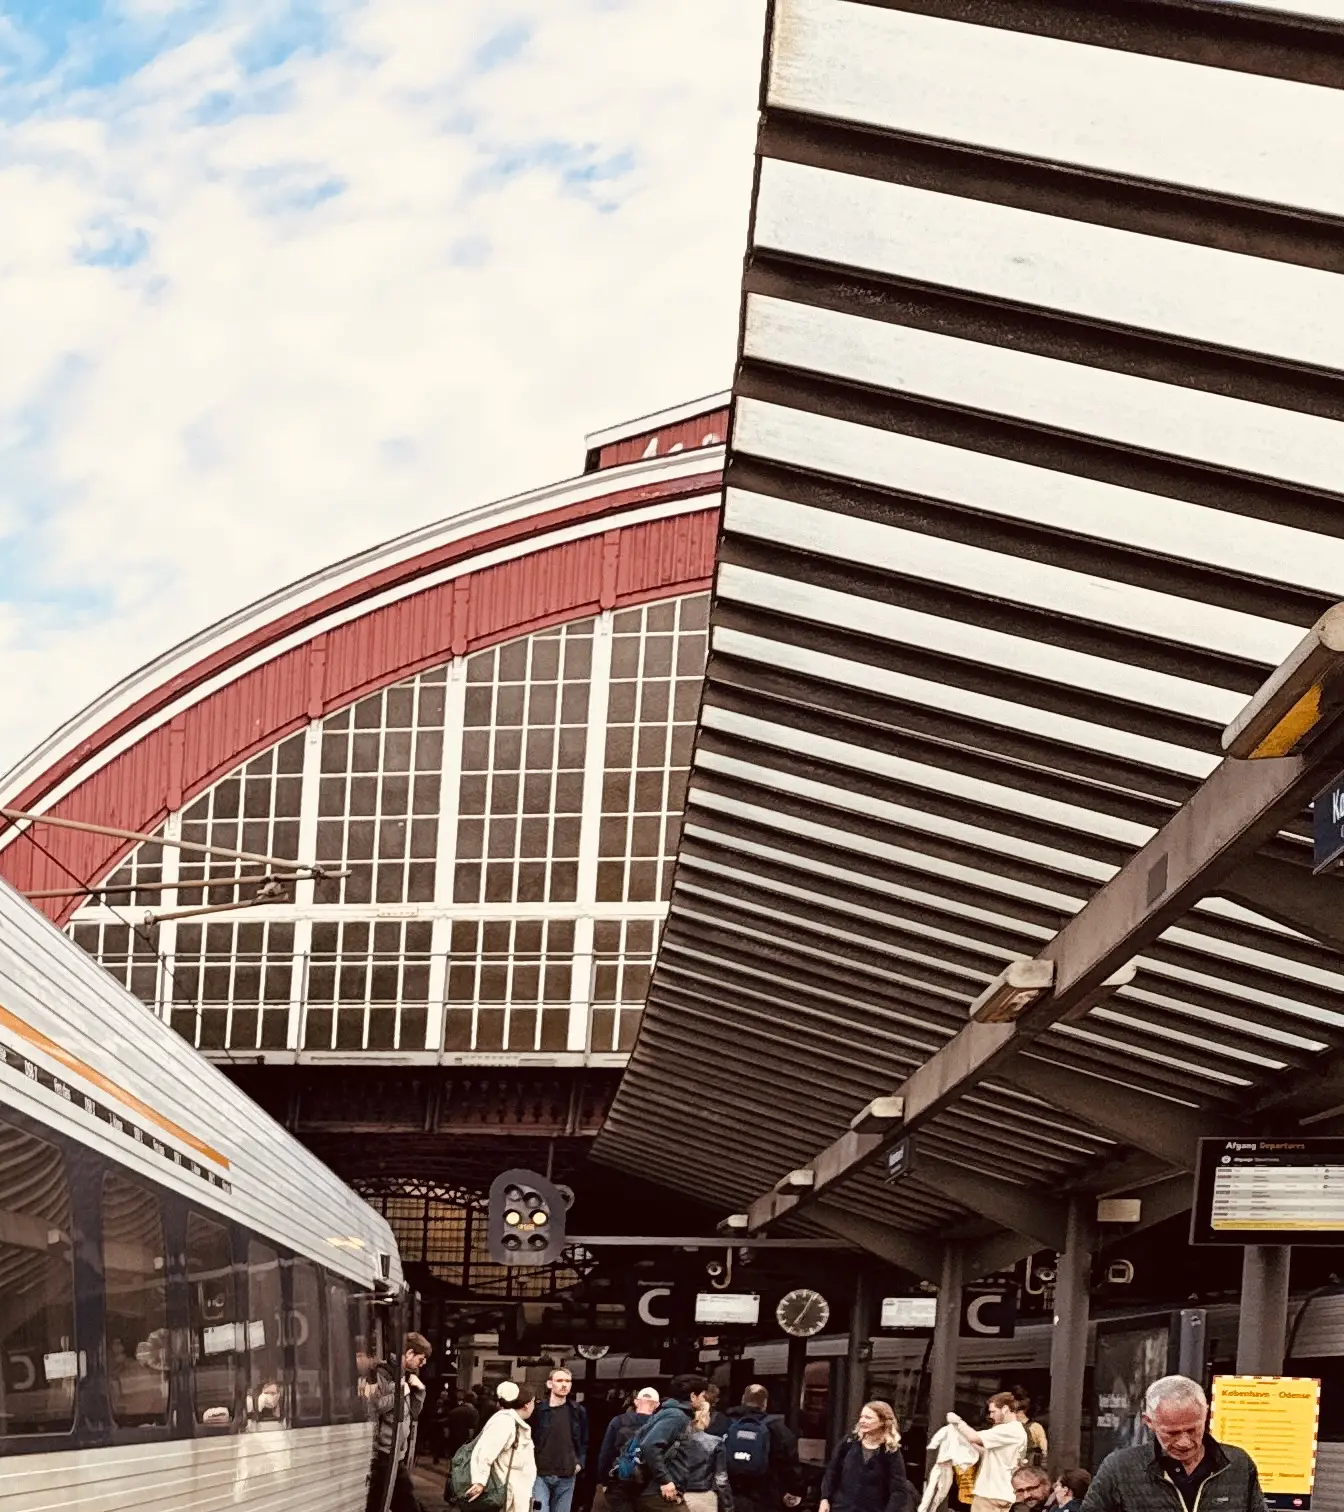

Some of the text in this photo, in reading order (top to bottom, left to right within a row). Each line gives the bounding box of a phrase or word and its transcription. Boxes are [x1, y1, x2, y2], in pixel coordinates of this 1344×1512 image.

[1225, 1141, 1257, 1151] Afgang
[638, 1288, 671, 1326] C
[966, 1295, 1002, 1334] C
